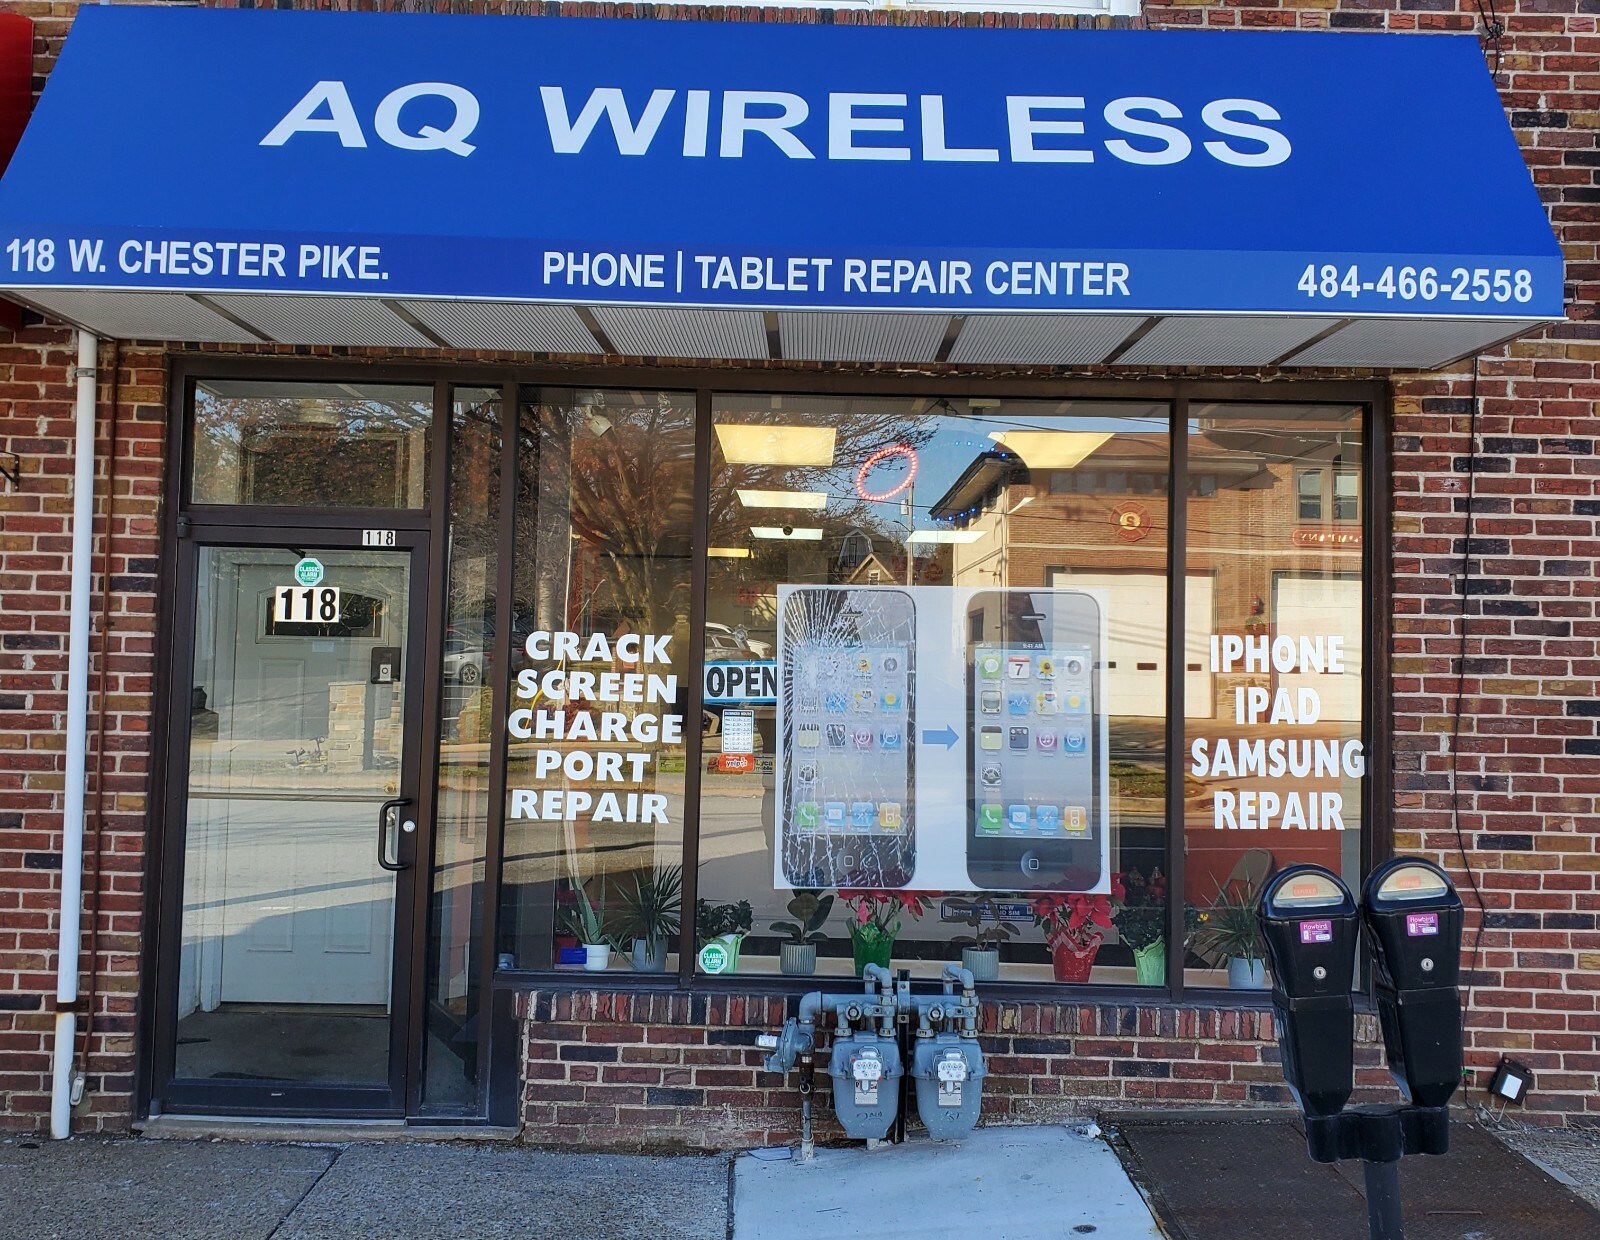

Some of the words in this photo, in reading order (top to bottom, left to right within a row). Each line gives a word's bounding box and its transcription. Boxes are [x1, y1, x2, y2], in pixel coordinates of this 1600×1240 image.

[260, 80, 480, 157] AQ
[540, 86, 1292, 167] WIRELESS
[6, 238, 55, 273] 118
[68, 239, 106, 274] W.
[118, 239, 286, 277] CHESTER
[298, 244, 389, 280] PIKE.
[543, 250, 666, 288] PHONE
[694, 255, 833, 292] TABLET
[844, 258, 973, 294] REPAIR
[985, 260, 1131, 296] CENTER
[1297, 264, 1534, 303] 484-466-2558
[366, 530, 394, 545] 118
[281, 588, 337, 621] 118
[525, 631, 673, 664] CRACK
[1210, 635, 1345, 673] IPHONE
[516, 669, 678, 704] SCREEN
[706, 666, 777, 698] OPEN
[1015, 664, 1023, 676] 7
[1235, 687, 1321, 725] IPAD
[507, 708, 683, 744] CHARGE
[535, 749, 651, 782] PORT
[1191, 738, 1366, 778] SAMSUNG
[510, 789, 669, 824] REPAIR
[1213, 791, 1346, 831] REPAIR
